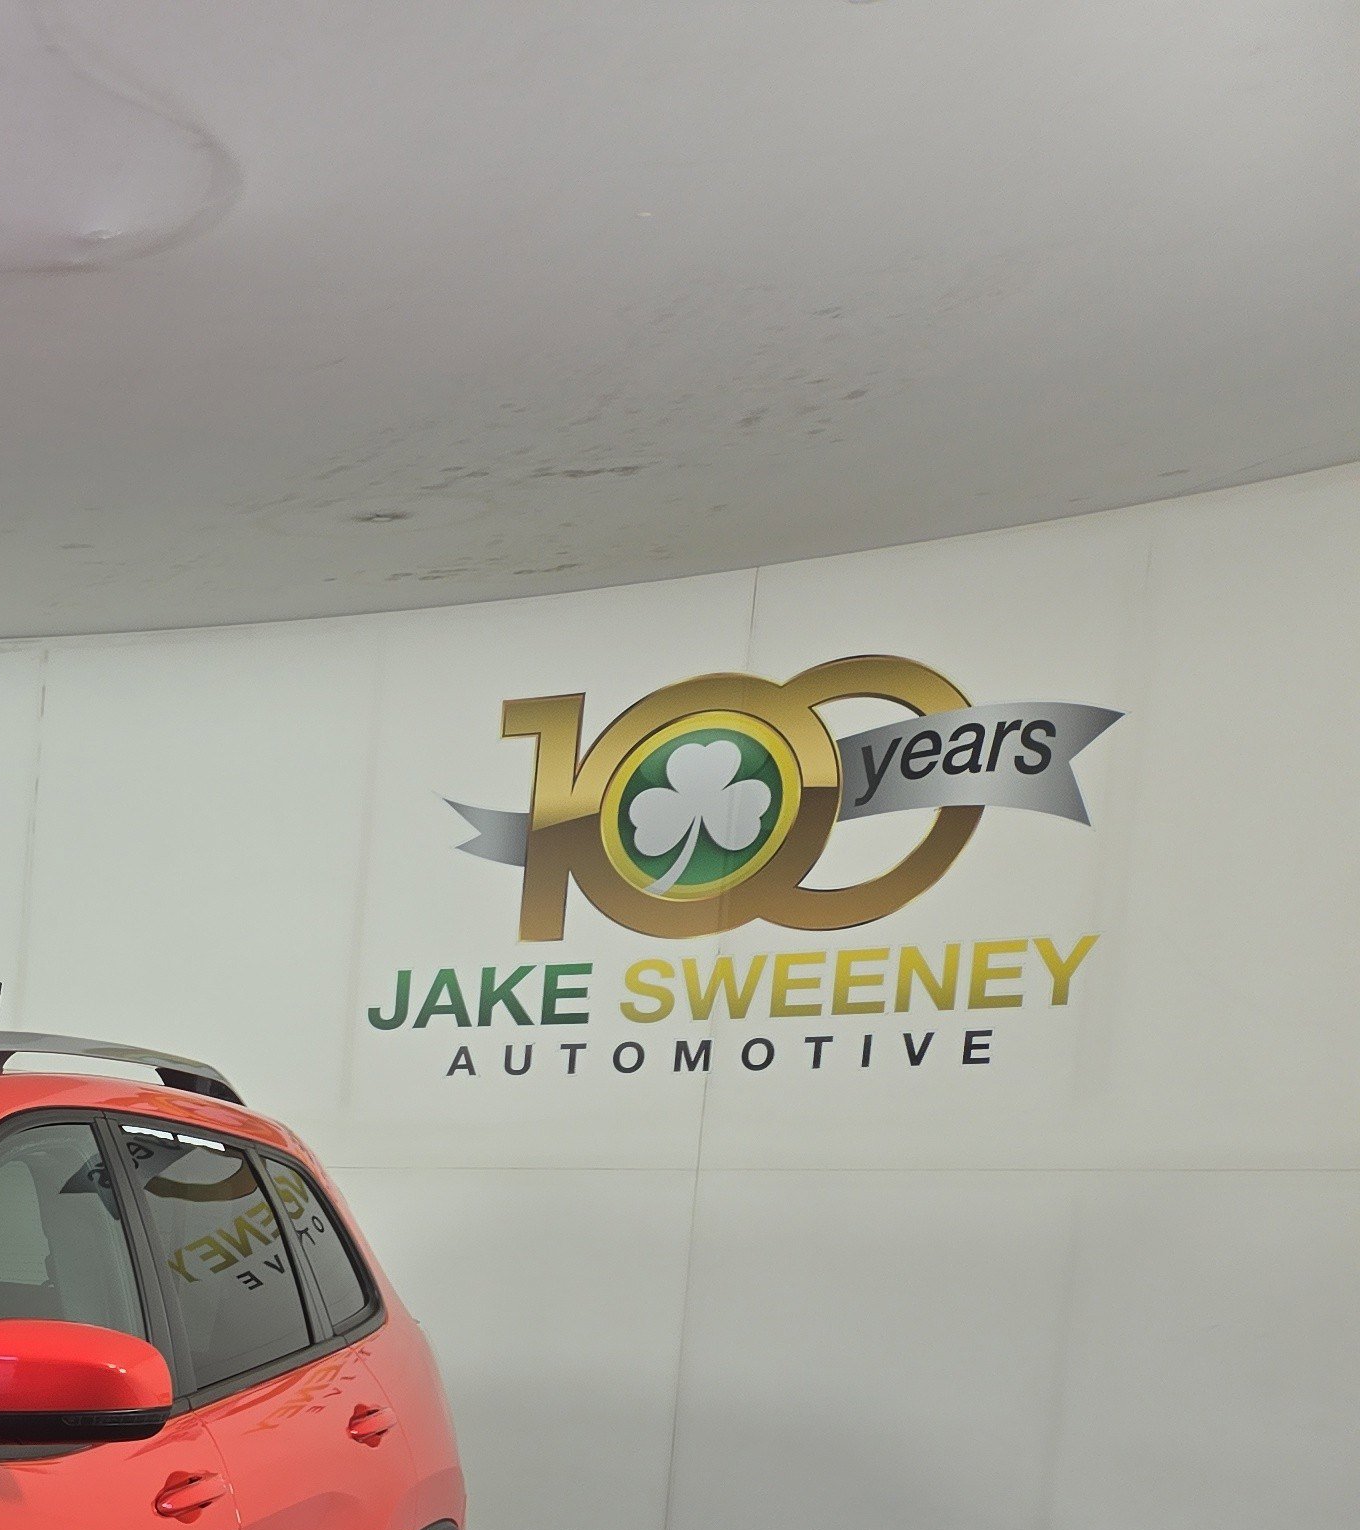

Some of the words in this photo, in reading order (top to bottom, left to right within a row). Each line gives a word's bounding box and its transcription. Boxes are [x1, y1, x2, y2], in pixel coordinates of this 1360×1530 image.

[501, 654, 984, 943] 100
[855, 716, 1056, 807] years
[367, 962, 593, 1030] JAKE
[619, 933, 1100, 1024] SWEENEY
[446, 1029, 993, 1077] AUTOMOTIVE
